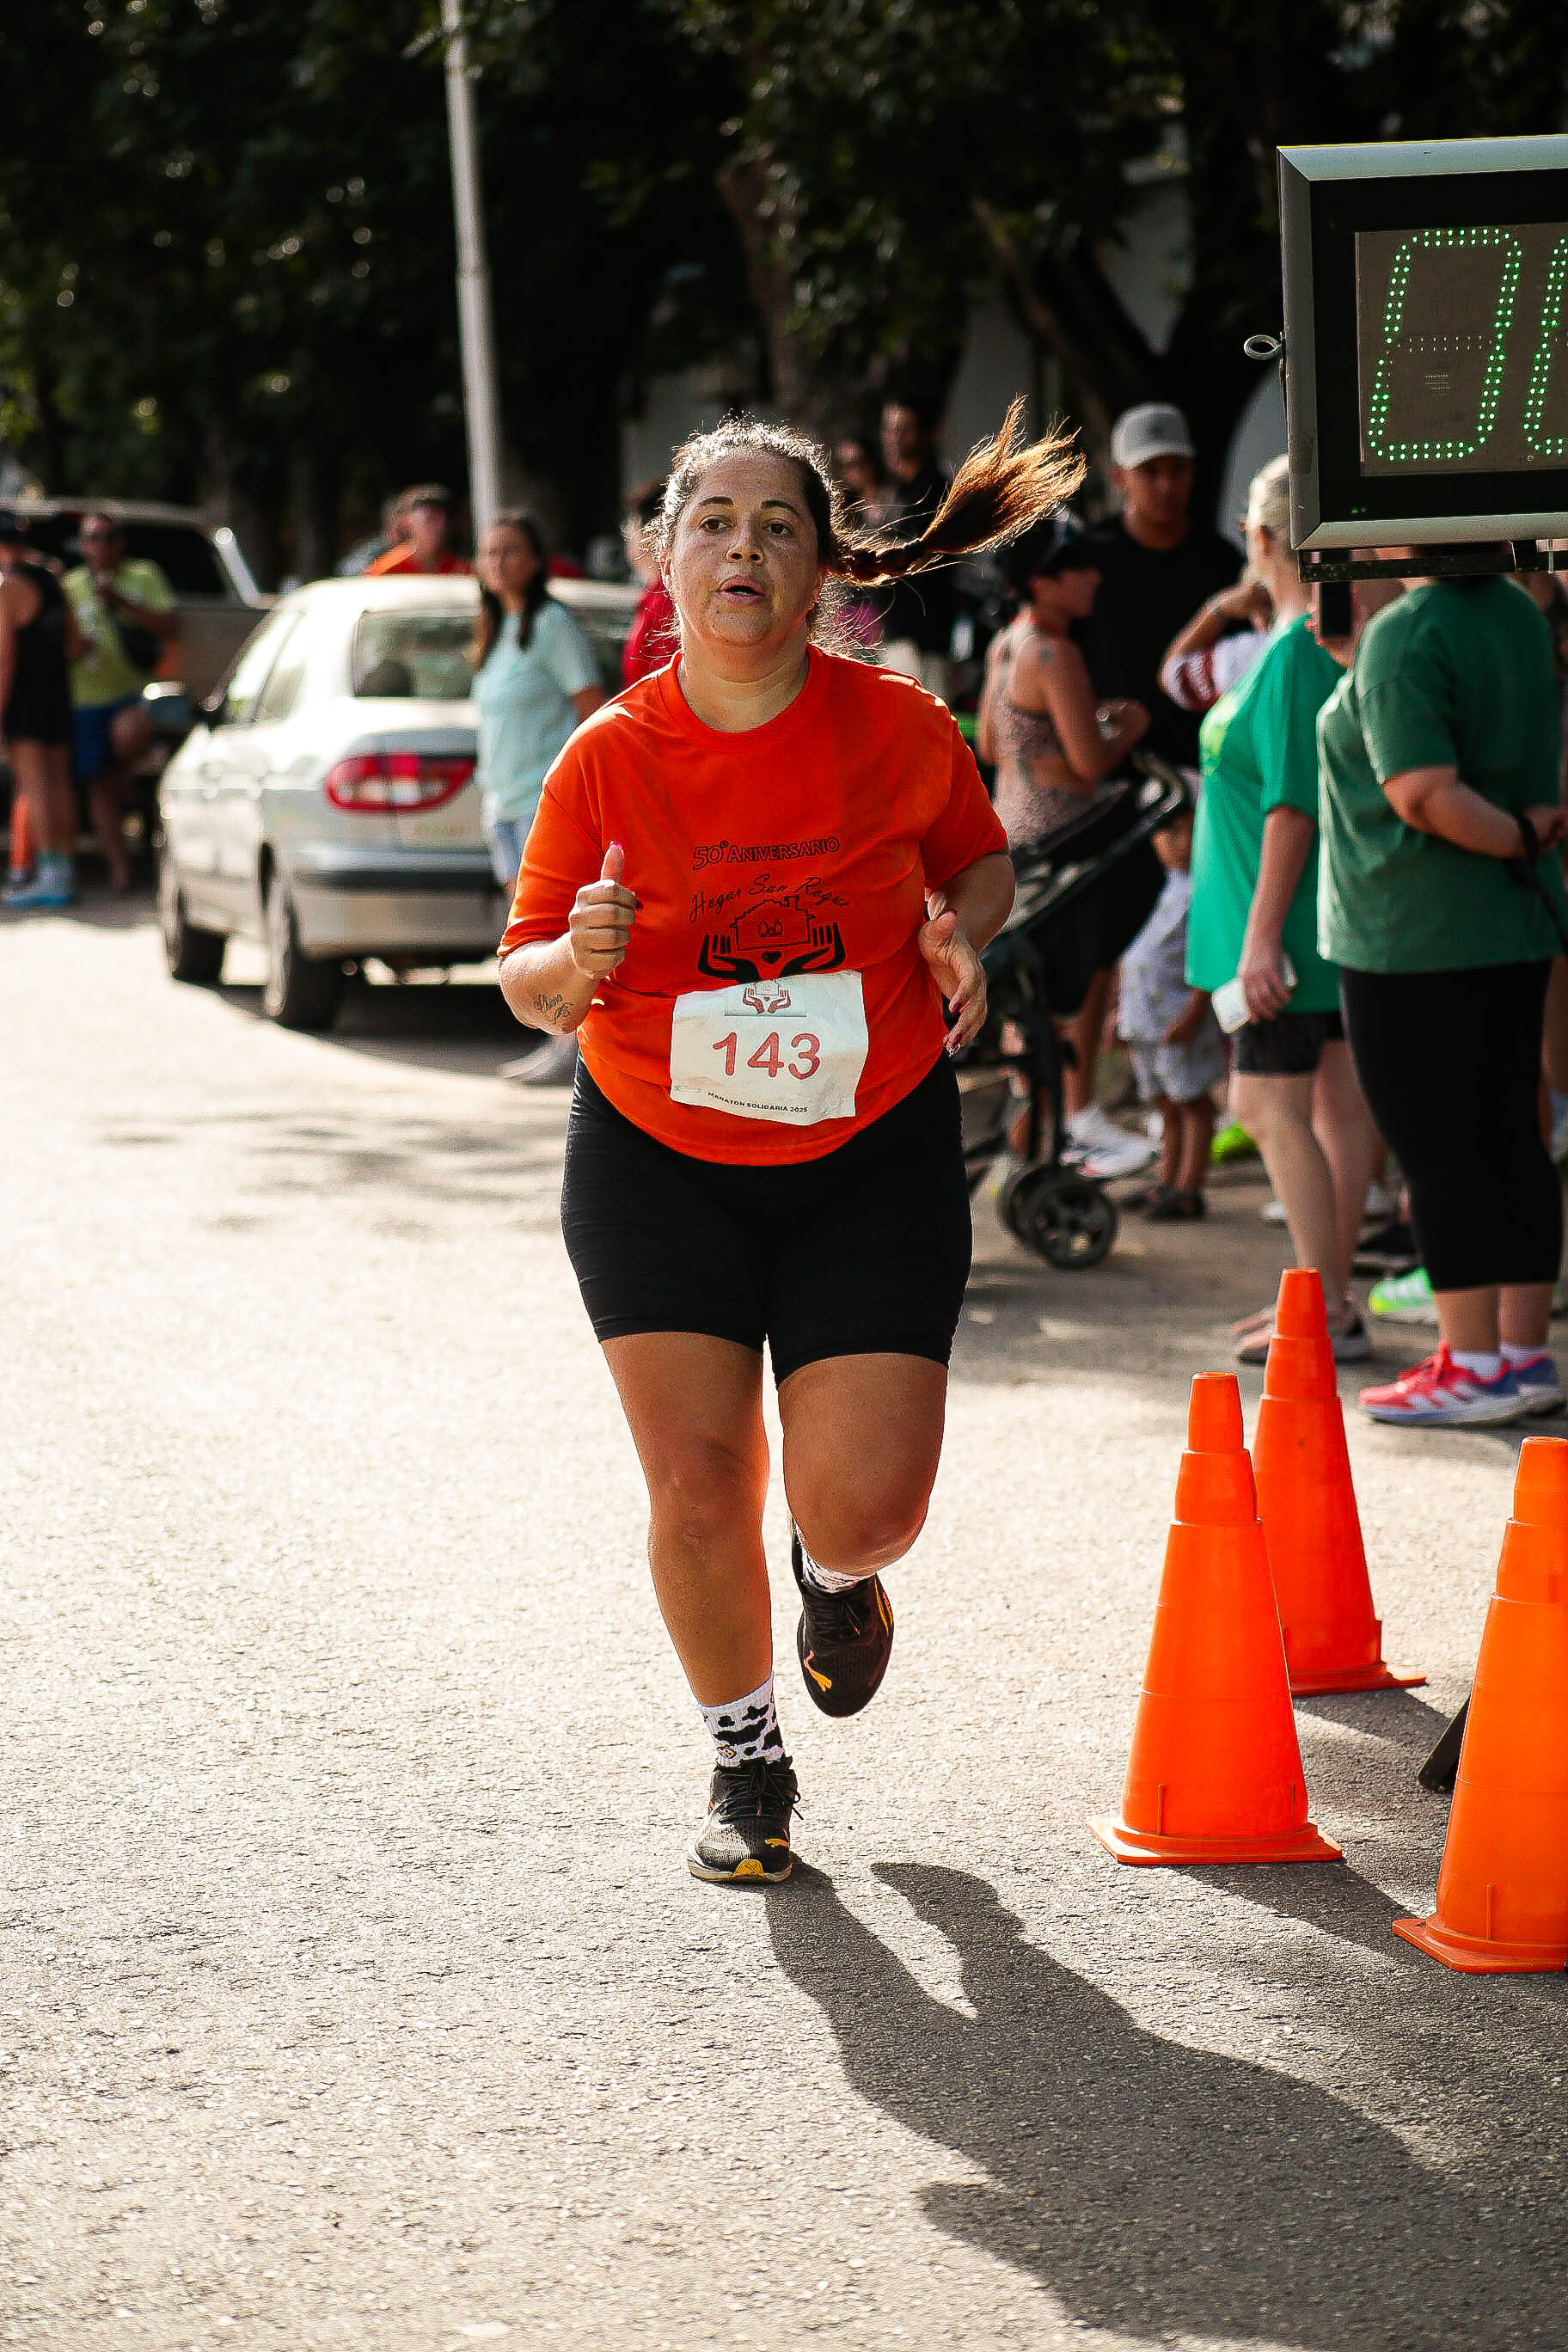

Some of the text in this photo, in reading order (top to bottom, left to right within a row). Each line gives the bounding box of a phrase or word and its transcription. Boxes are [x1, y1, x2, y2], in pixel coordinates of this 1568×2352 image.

[727, 836, 840, 862] ANIVERSARIO
[689, 873, 851, 923] Hogar San Roque
[712, 1032, 821, 1081] 143
[707, 1091, 745, 1107] MARATON
[746, 1102, 788, 1112] SOLIDARIA
